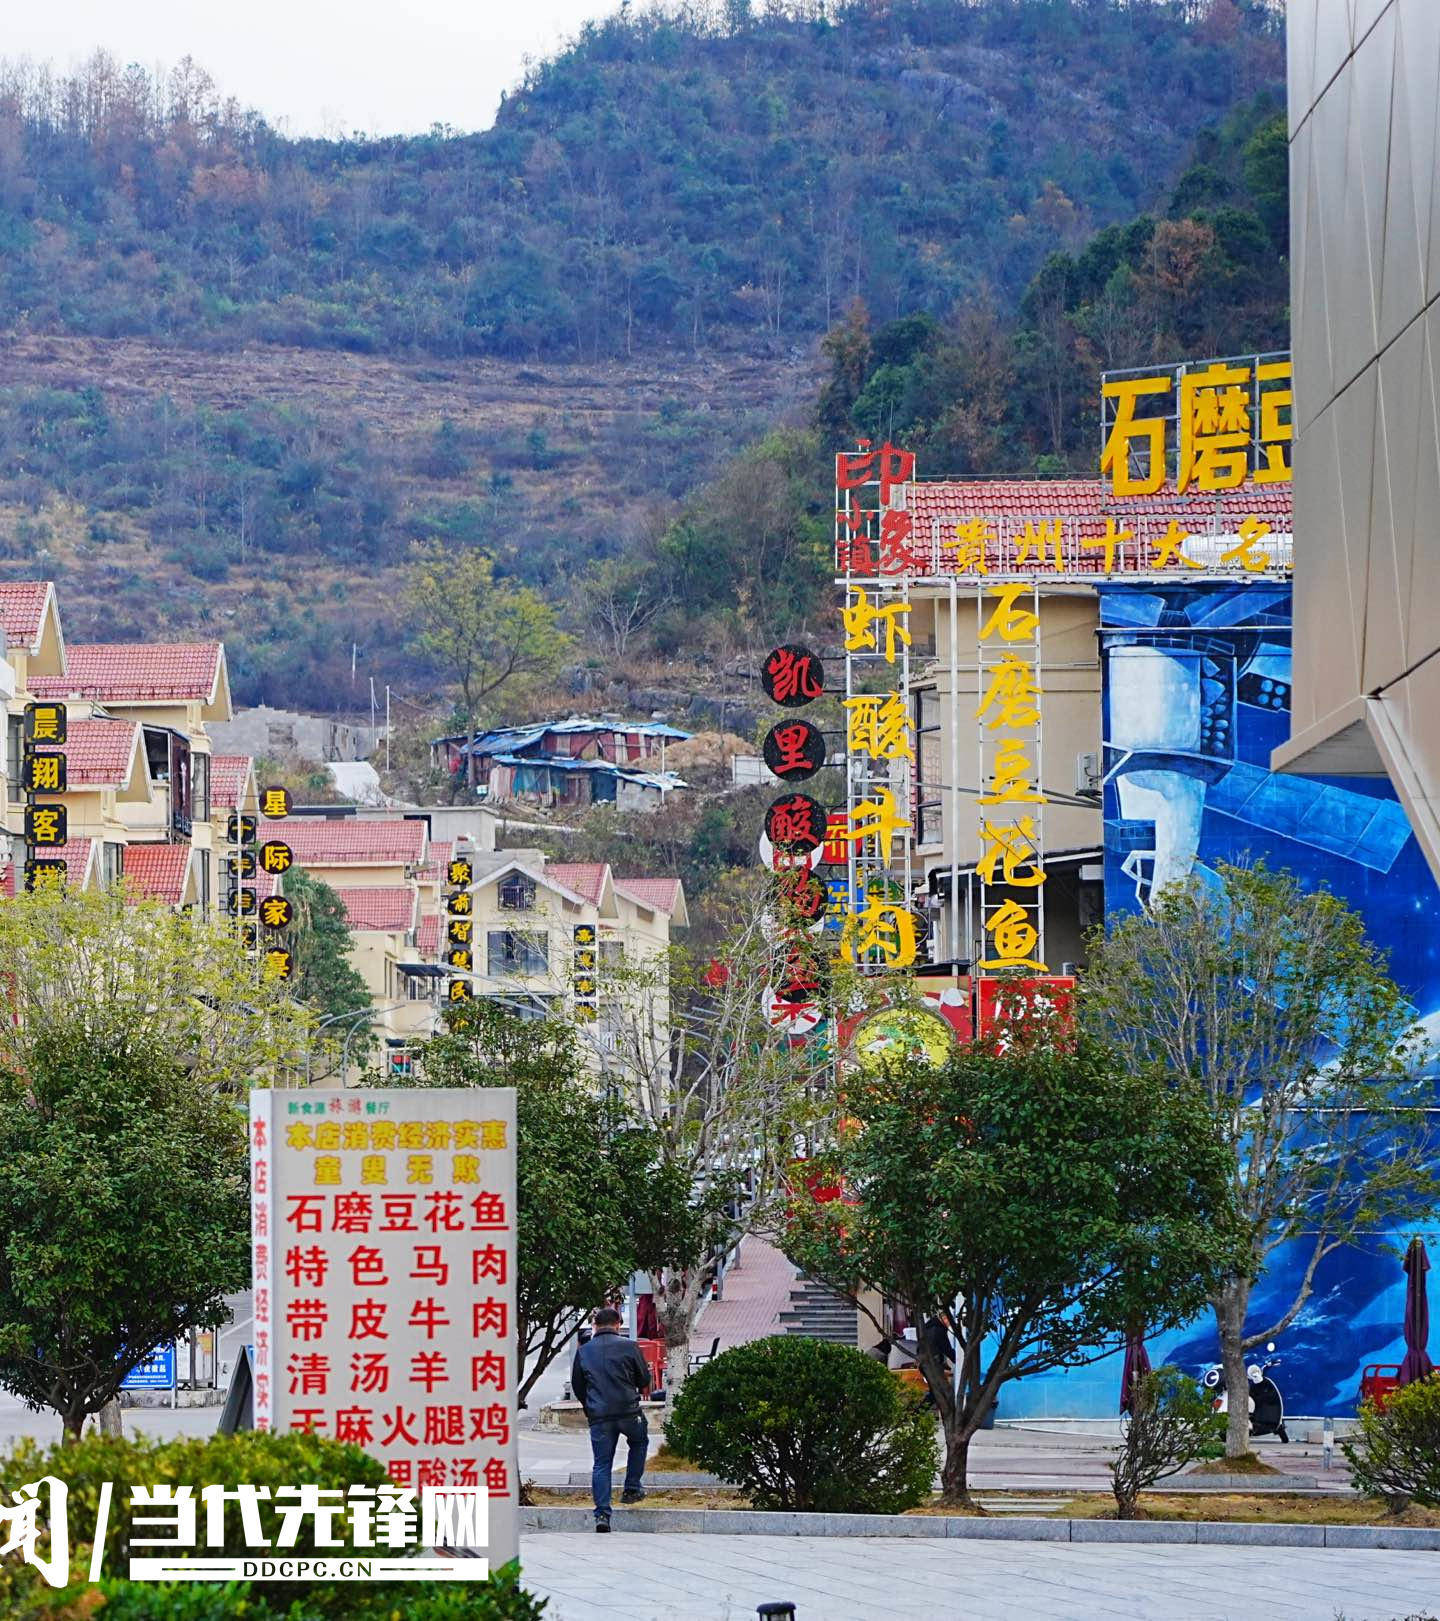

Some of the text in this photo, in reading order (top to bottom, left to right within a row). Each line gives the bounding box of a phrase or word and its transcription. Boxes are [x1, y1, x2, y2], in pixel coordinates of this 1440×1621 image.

[840, 586, 916, 968] 虾酸牛肉
[976, 583, 1049, 972] 石磨豆花鱼
[286, 1120, 508, 1151] 本店消费经济实惠
[314, 1154, 480, 1185] 童叟无欺
[286, 1190, 509, 1233] 石磨豆花鱼
[286, 1243, 507, 1287] 特色马肉
[286, 1297, 508, 1341] 带皮牛肉
[287, 1350, 507, 1395] 清汤羊肉
